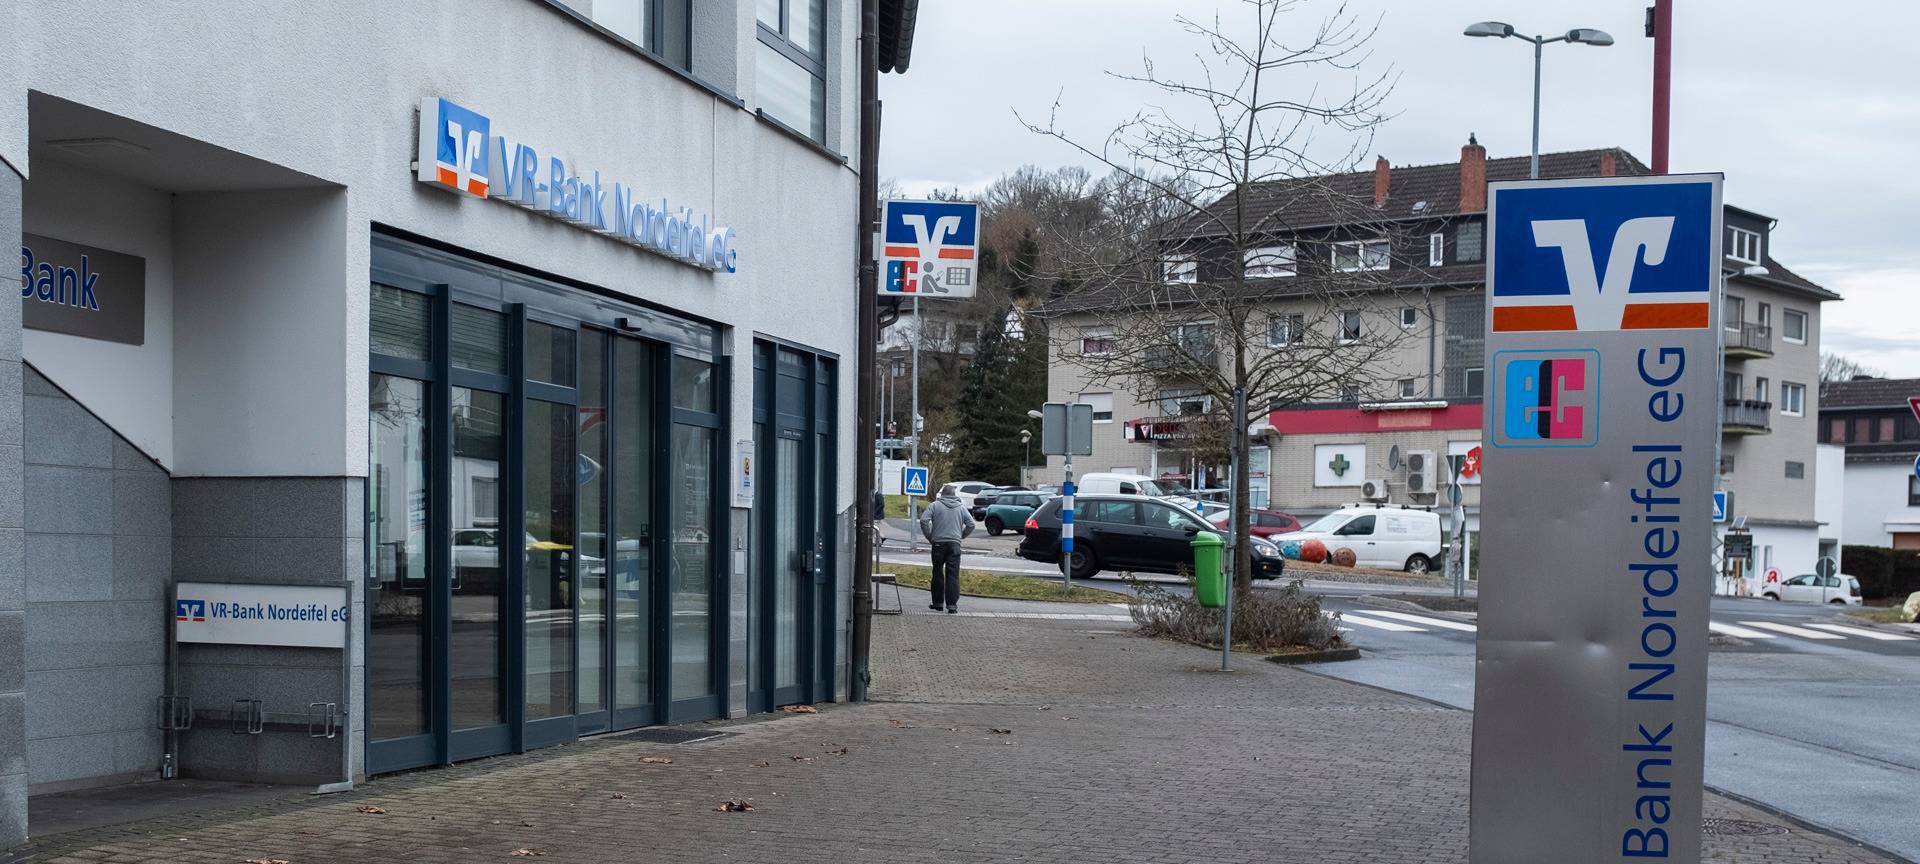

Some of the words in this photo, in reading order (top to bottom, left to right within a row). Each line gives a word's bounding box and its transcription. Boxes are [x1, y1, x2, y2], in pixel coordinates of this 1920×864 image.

[499, 136, 608, 230] VR-Bank
[615, 182, 706, 263] Nordeifel
[712, 227, 737, 273] eG
[21, 246, 100, 311] Bank
[1637, 347, 1686, 422] eG
[210, 602, 264, 620] VR-Bank
[268, 604, 327, 622] Nordeifel
[331, 606, 347, 622] eG
[1627, 445, 1682, 701] Nordeifel
[1622, 722, 1674, 857] Bank
